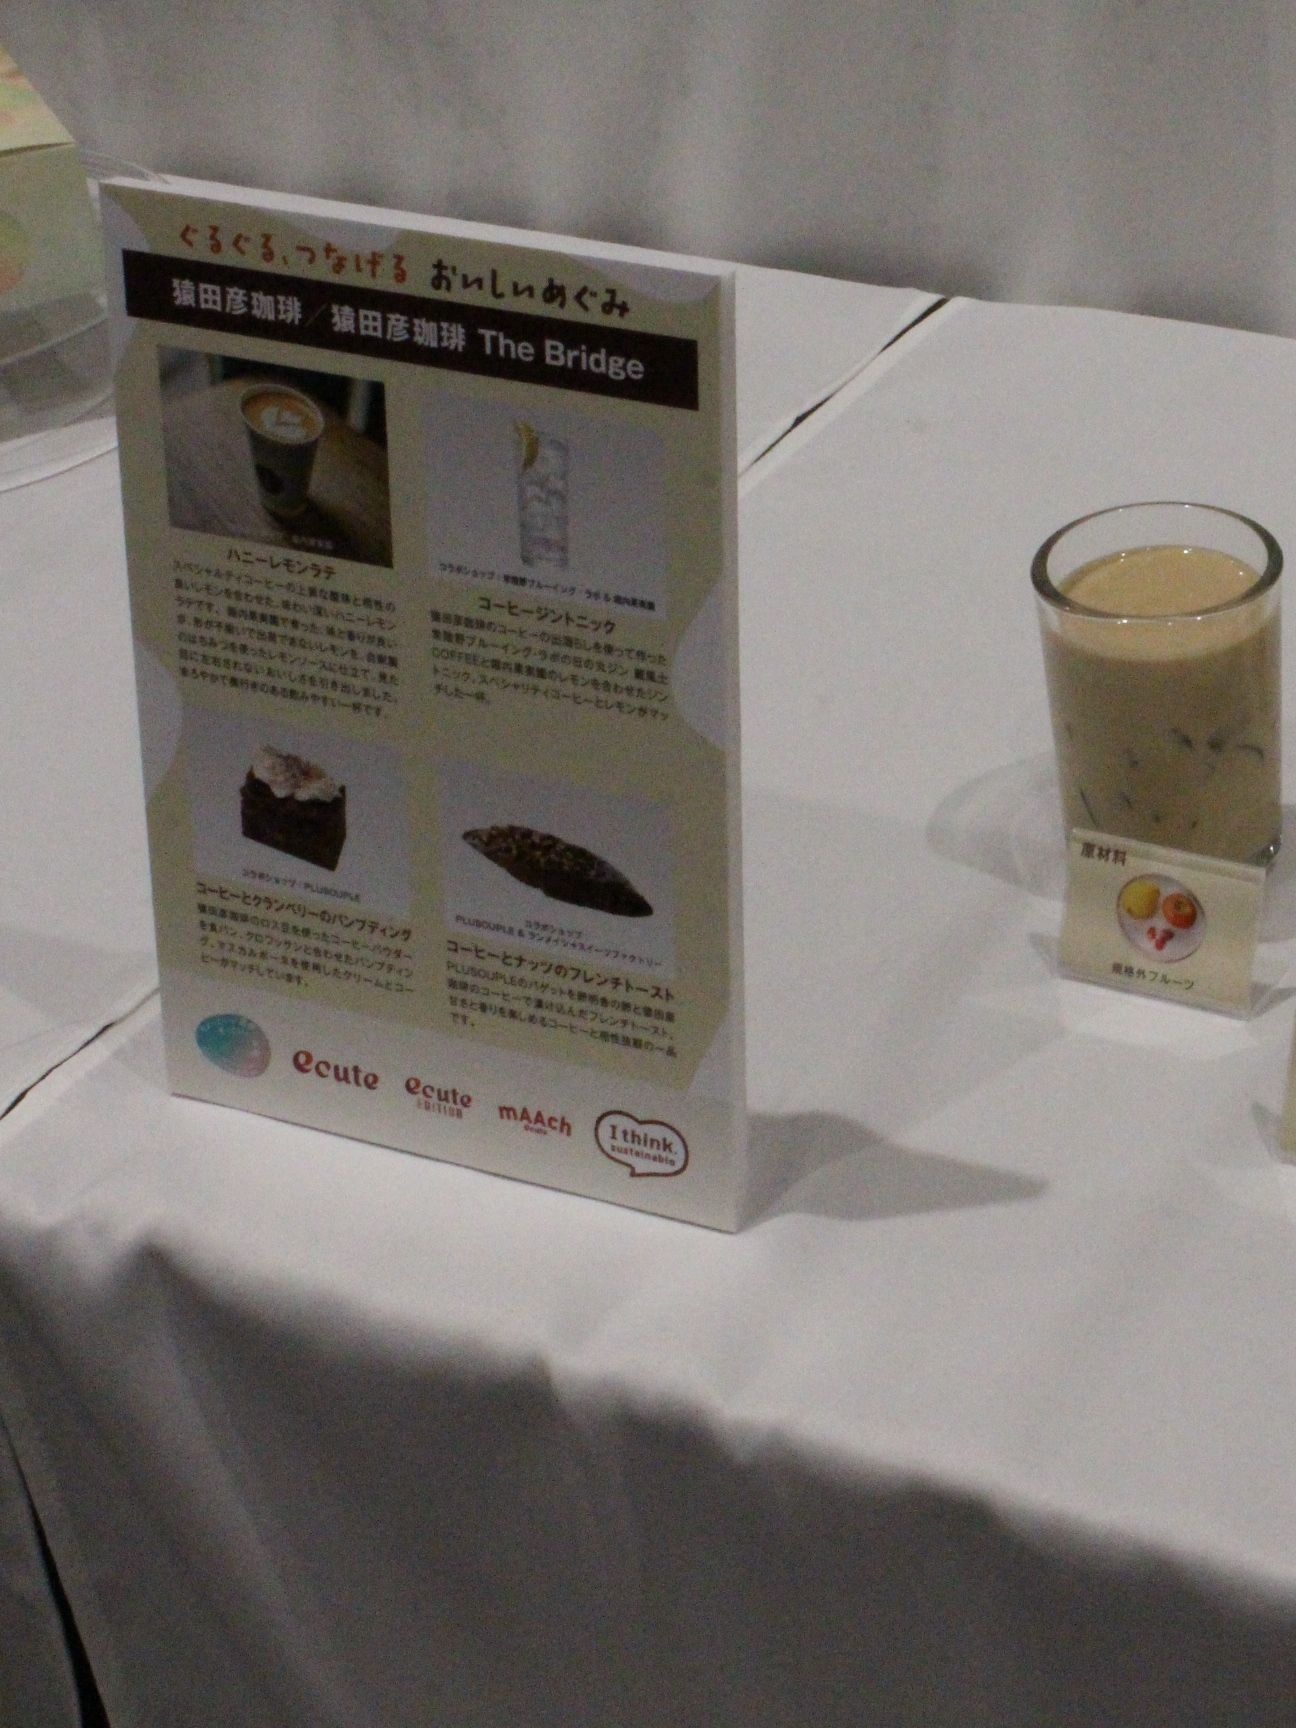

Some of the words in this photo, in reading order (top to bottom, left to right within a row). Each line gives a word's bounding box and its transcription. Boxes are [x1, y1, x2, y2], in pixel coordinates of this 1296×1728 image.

[430, 257, 631, 318] おいしいめぐみ
[478, 328, 534, 362] The
[544, 338, 645, 382] Bridge
[226, 549, 336, 577] ハニーレモンラテ
[478, 597, 616, 631] コーヒージントニック
[1080, 841, 1127, 866] 原材料
[447, 940, 674, 999] コーヒーとナッツのフレンチトースト
[1112, 962, 1194, 990] 規格外フルーツ
[292, 1047, 379, 1092] ecute
[405, 1075, 472, 1109] ecute
[498, 1101, 571, 1136] mAAch
